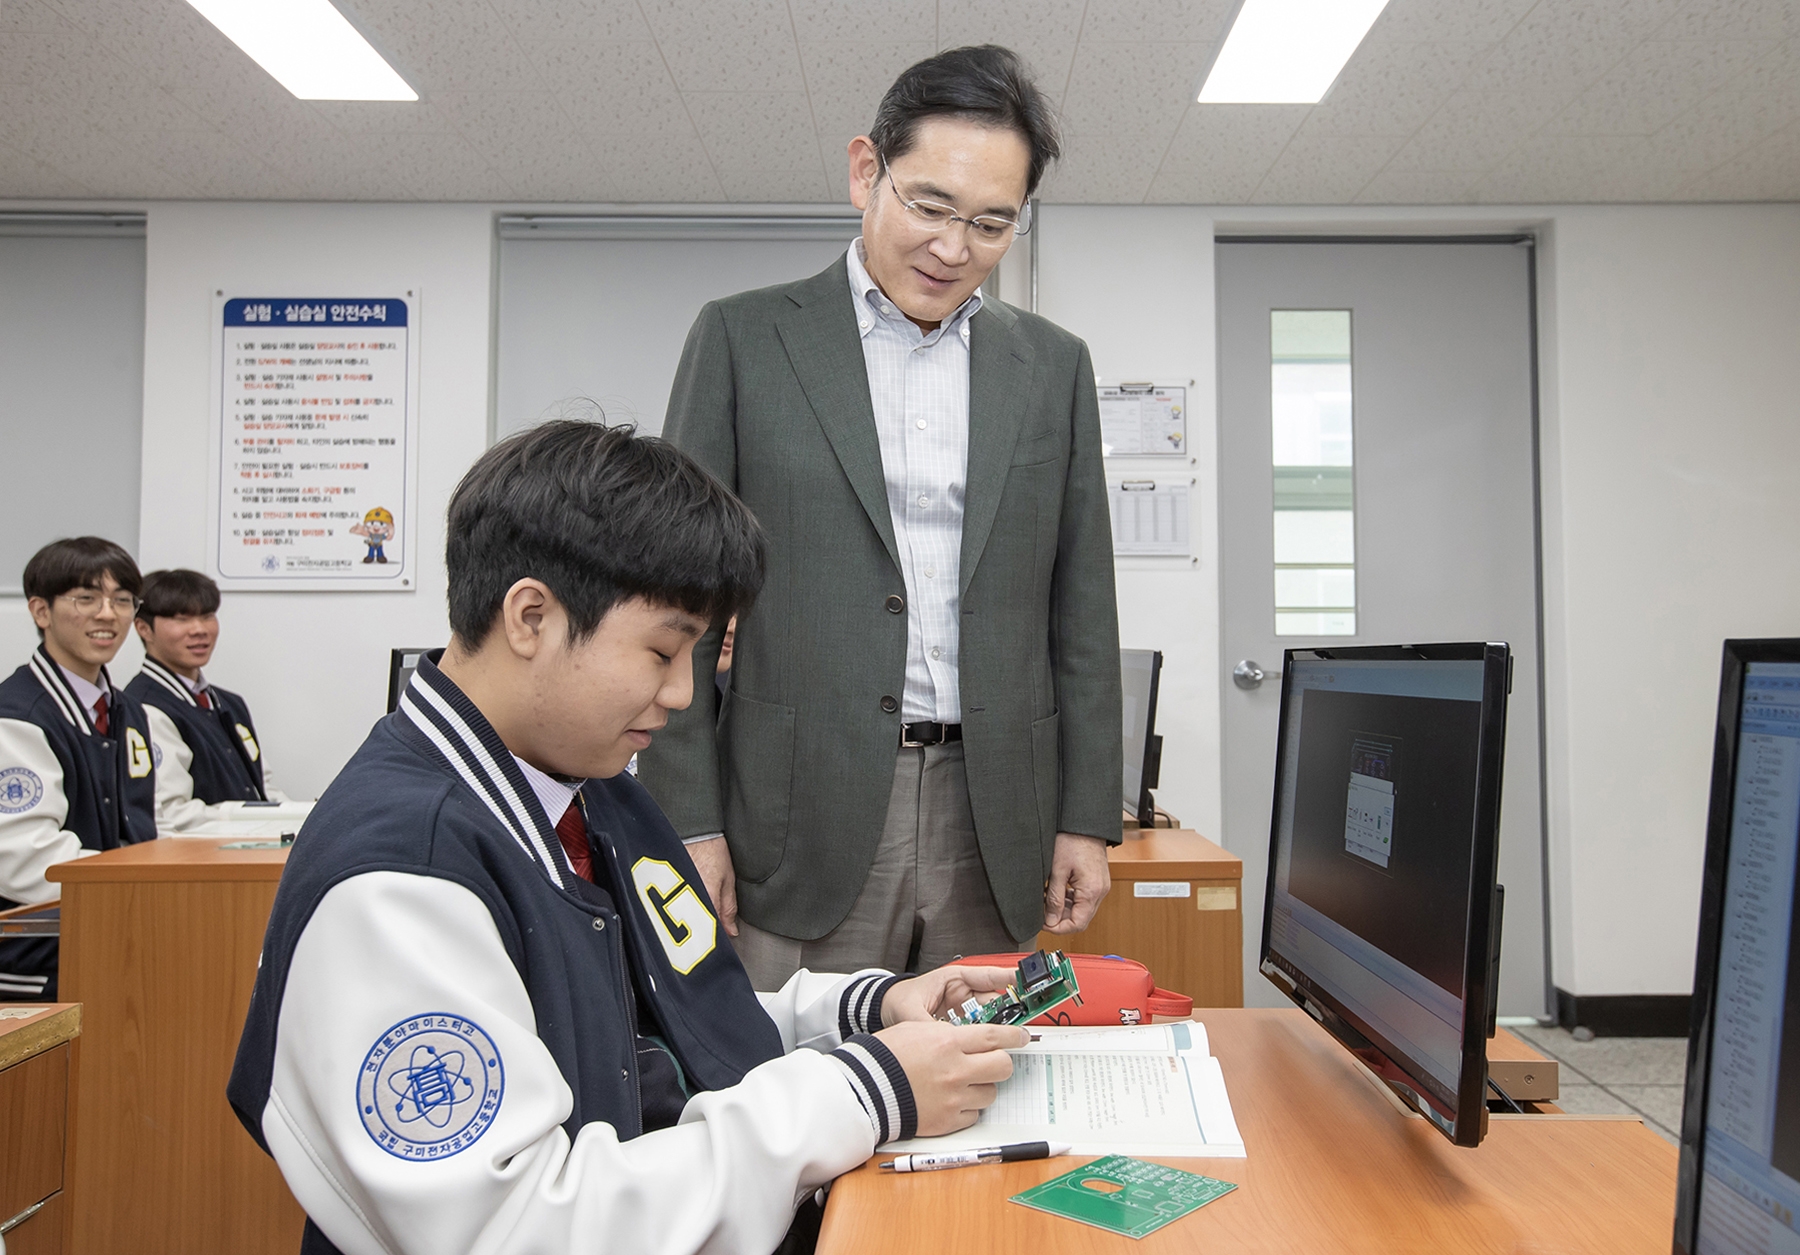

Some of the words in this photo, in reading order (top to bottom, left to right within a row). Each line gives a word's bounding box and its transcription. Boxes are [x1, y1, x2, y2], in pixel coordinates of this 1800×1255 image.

[243, 304, 271, 322] 실험
[285, 304, 326, 322] 실습실
[330, 304, 386, 322] 안전수칙
[126, 727, 153, 779] G
[631, 856, 717, 975] G
[366, 1017, 475, 1073] 전자분야마이스터고
[377, 1129, 399, 1150] 국립
[403, 1088, 499, 1157] 구미전자공업고등학교
